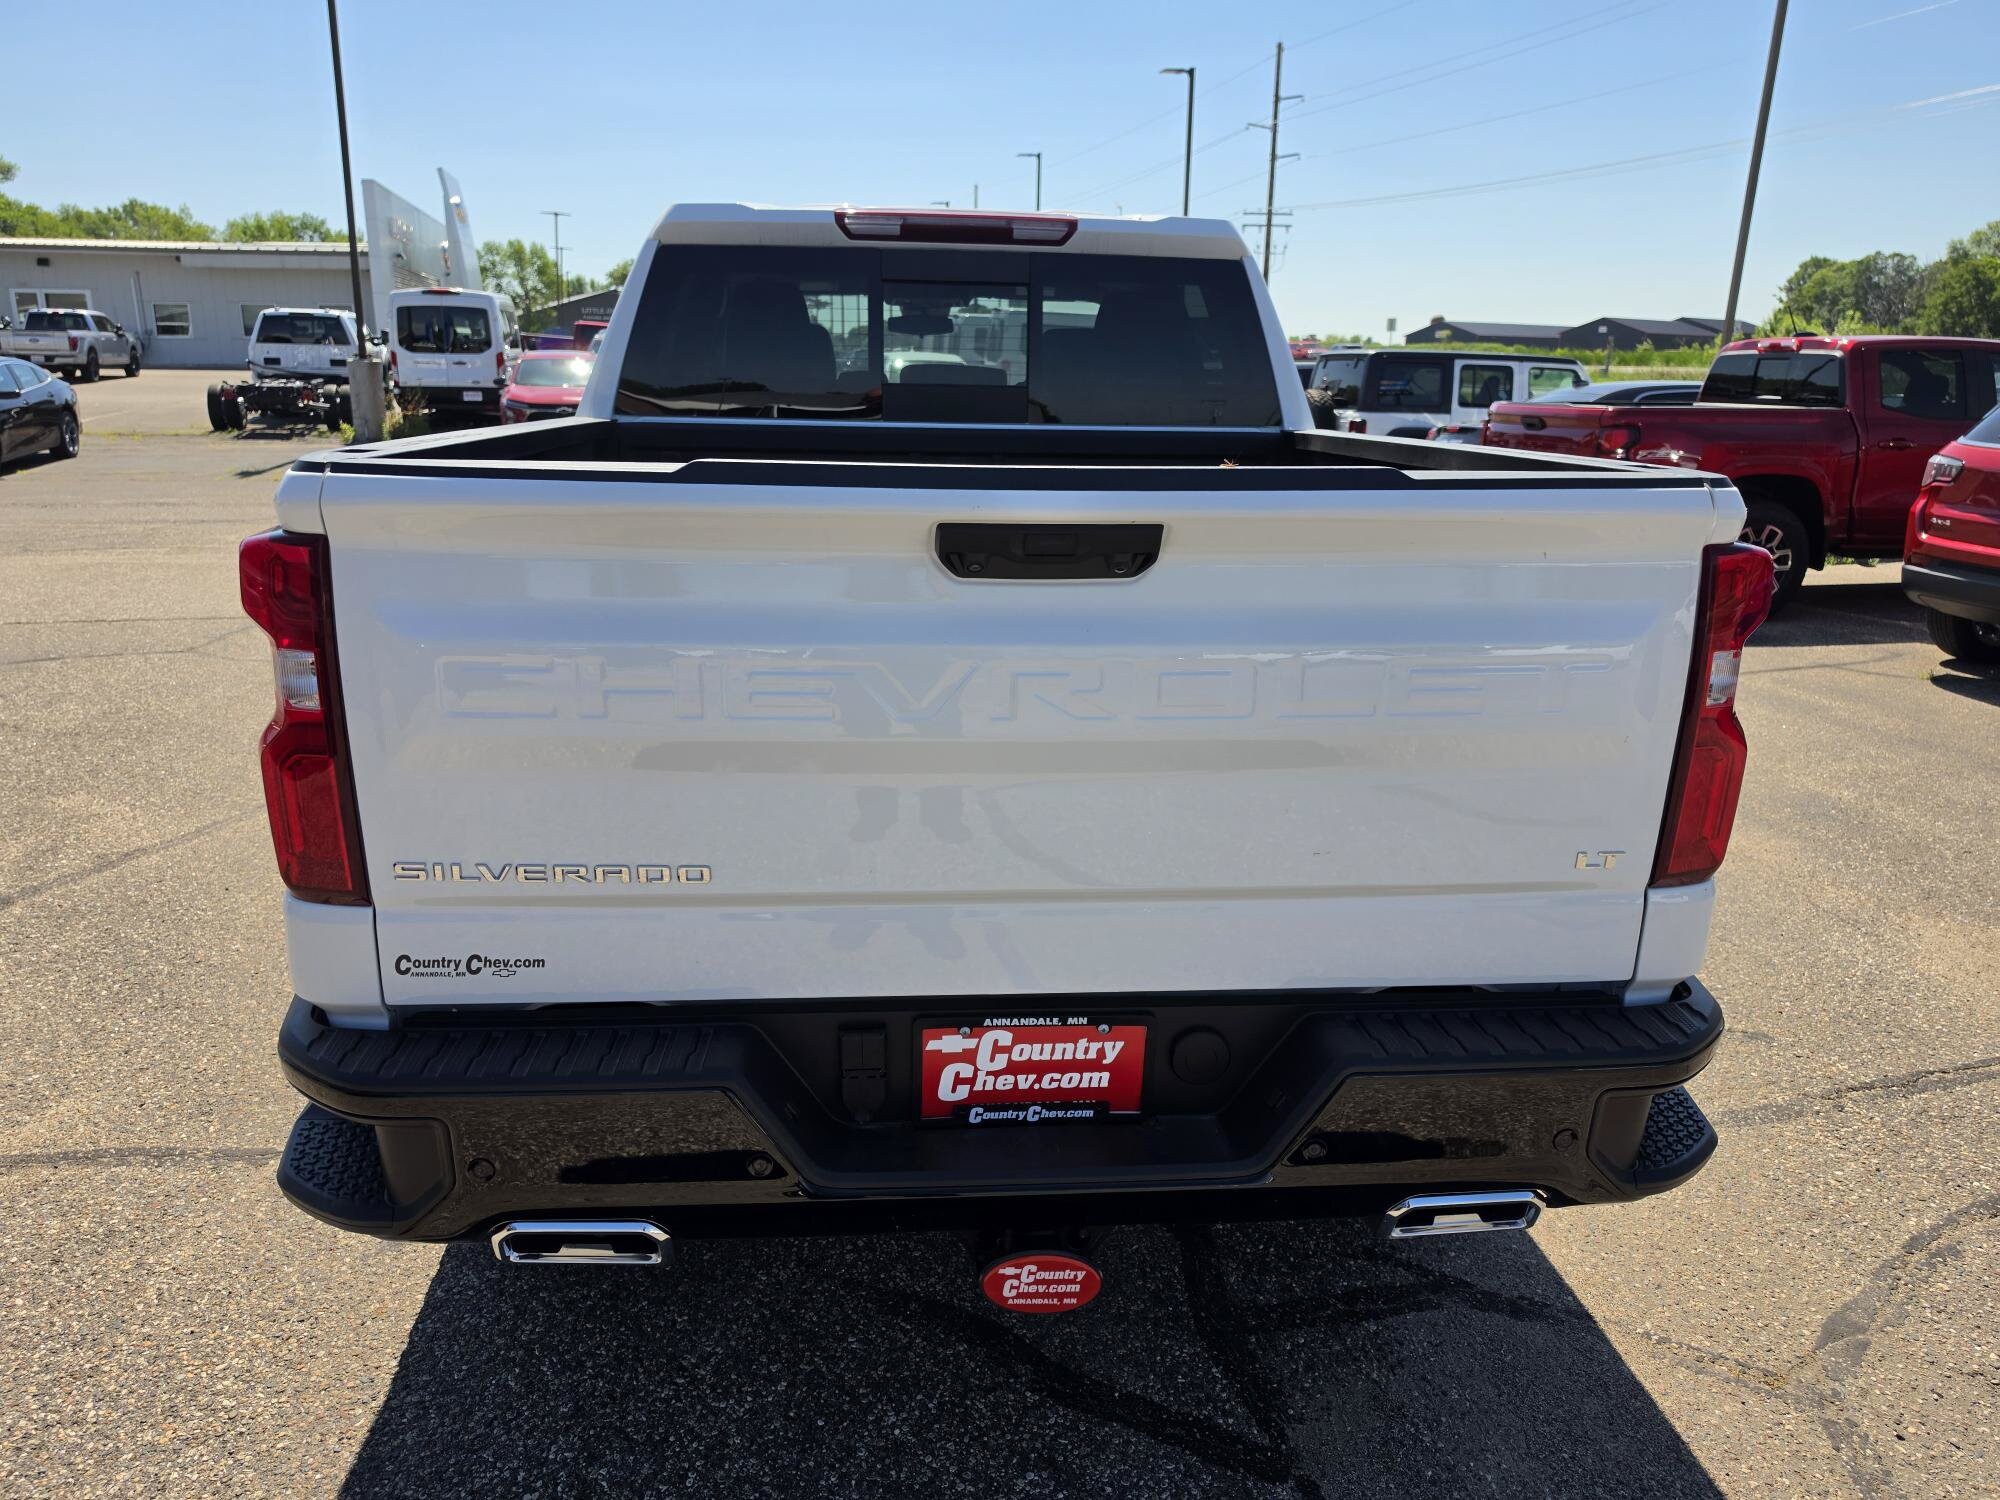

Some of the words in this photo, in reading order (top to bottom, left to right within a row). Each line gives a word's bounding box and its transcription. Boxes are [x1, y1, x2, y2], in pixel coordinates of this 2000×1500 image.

[435, 655, 1615, 720] CHEVROLET
[1574, 850, 1626, 871] LT
[393, 861, 713, 884] SILVERADO
[394, 954, 462, 976] Country
[465, 953, 546, 976] Chev.com
[983, 1017, 1063, 1027] ANNANDALE,
[1066, 1017, 1088, 1025] MN
[976, 1029, 1125, 1072] Country
[937, 1062, 1111, 1102] Chev.com
[1020, 1264, 1086, 1283] Country
[1002, 1278, 1081, 1298] Chev.com
